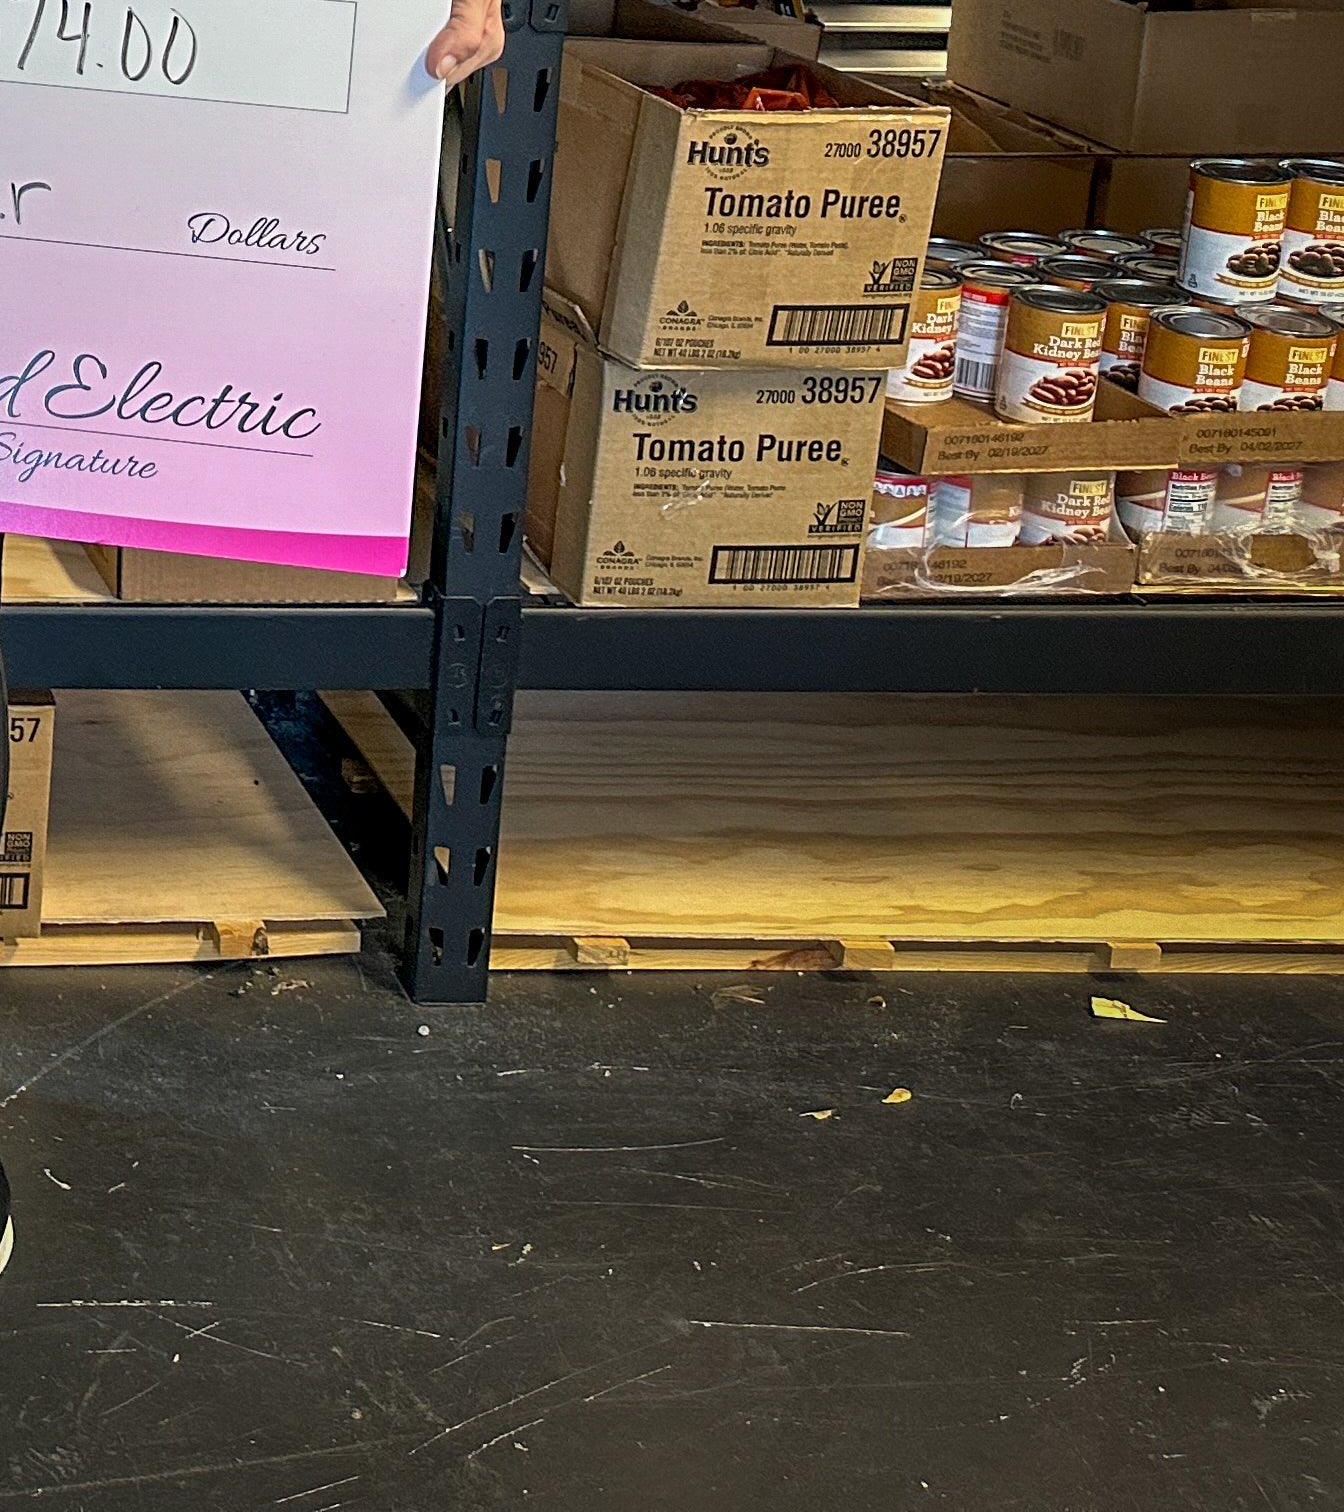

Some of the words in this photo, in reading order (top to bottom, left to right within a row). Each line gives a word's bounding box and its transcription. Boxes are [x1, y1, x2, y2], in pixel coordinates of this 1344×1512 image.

[824, 142, 862, 158] 27000
[867, 129, 943, 159] 38957
[687, 139, 771, 168] Hunt's
[704, 187, 811, 219] Tomato
[820, 188, 901, 219] Puree
[1256, 210, 1285, 222] Black
[704, 222, 725, 234] 1.06
[727, 222, 763, 236] specific
[765, 224, 798, 237] gravity
[1253, 221, 1285, 232] Beans
[186, 210, 328, 257] Dollars
[926, 313, 954, 324] Dark
[912, 322, 953, 335] Kidney
[1049, 336, 1082, 349] Dark
[1033, 343, 1082, 360] Kidney
[1201, 349, 1239, 363] FINEST
[1291, 349, 1327, 362] FINEST
[1198, 365, 1235, 376] Black
[1288, 364, 1324, 376] Black
[1195, 374, 1234, 386] Beans
[1285, 374, 1322, 385] Beans
[42, 353, 323, 441] Electric
[756, 390, 796, 405] 27000
[801, 376, 883, 405] 38957
[632, 433, 745, 463] Tomato
[756, 433, 843, 463] Puree
[635, 467, 657, 478] 1.06
[658, 467, 697, 479] specific
[698, 468, 733, 480] gravity
[1072, 481, 1107, 495] FINEST
[840, 501, 863, 509] NON
[1056, 493, 1091, 506] Dark
[839, 508, 863, 517] GMO
[1041, 500, 1090, 519] Kidney
